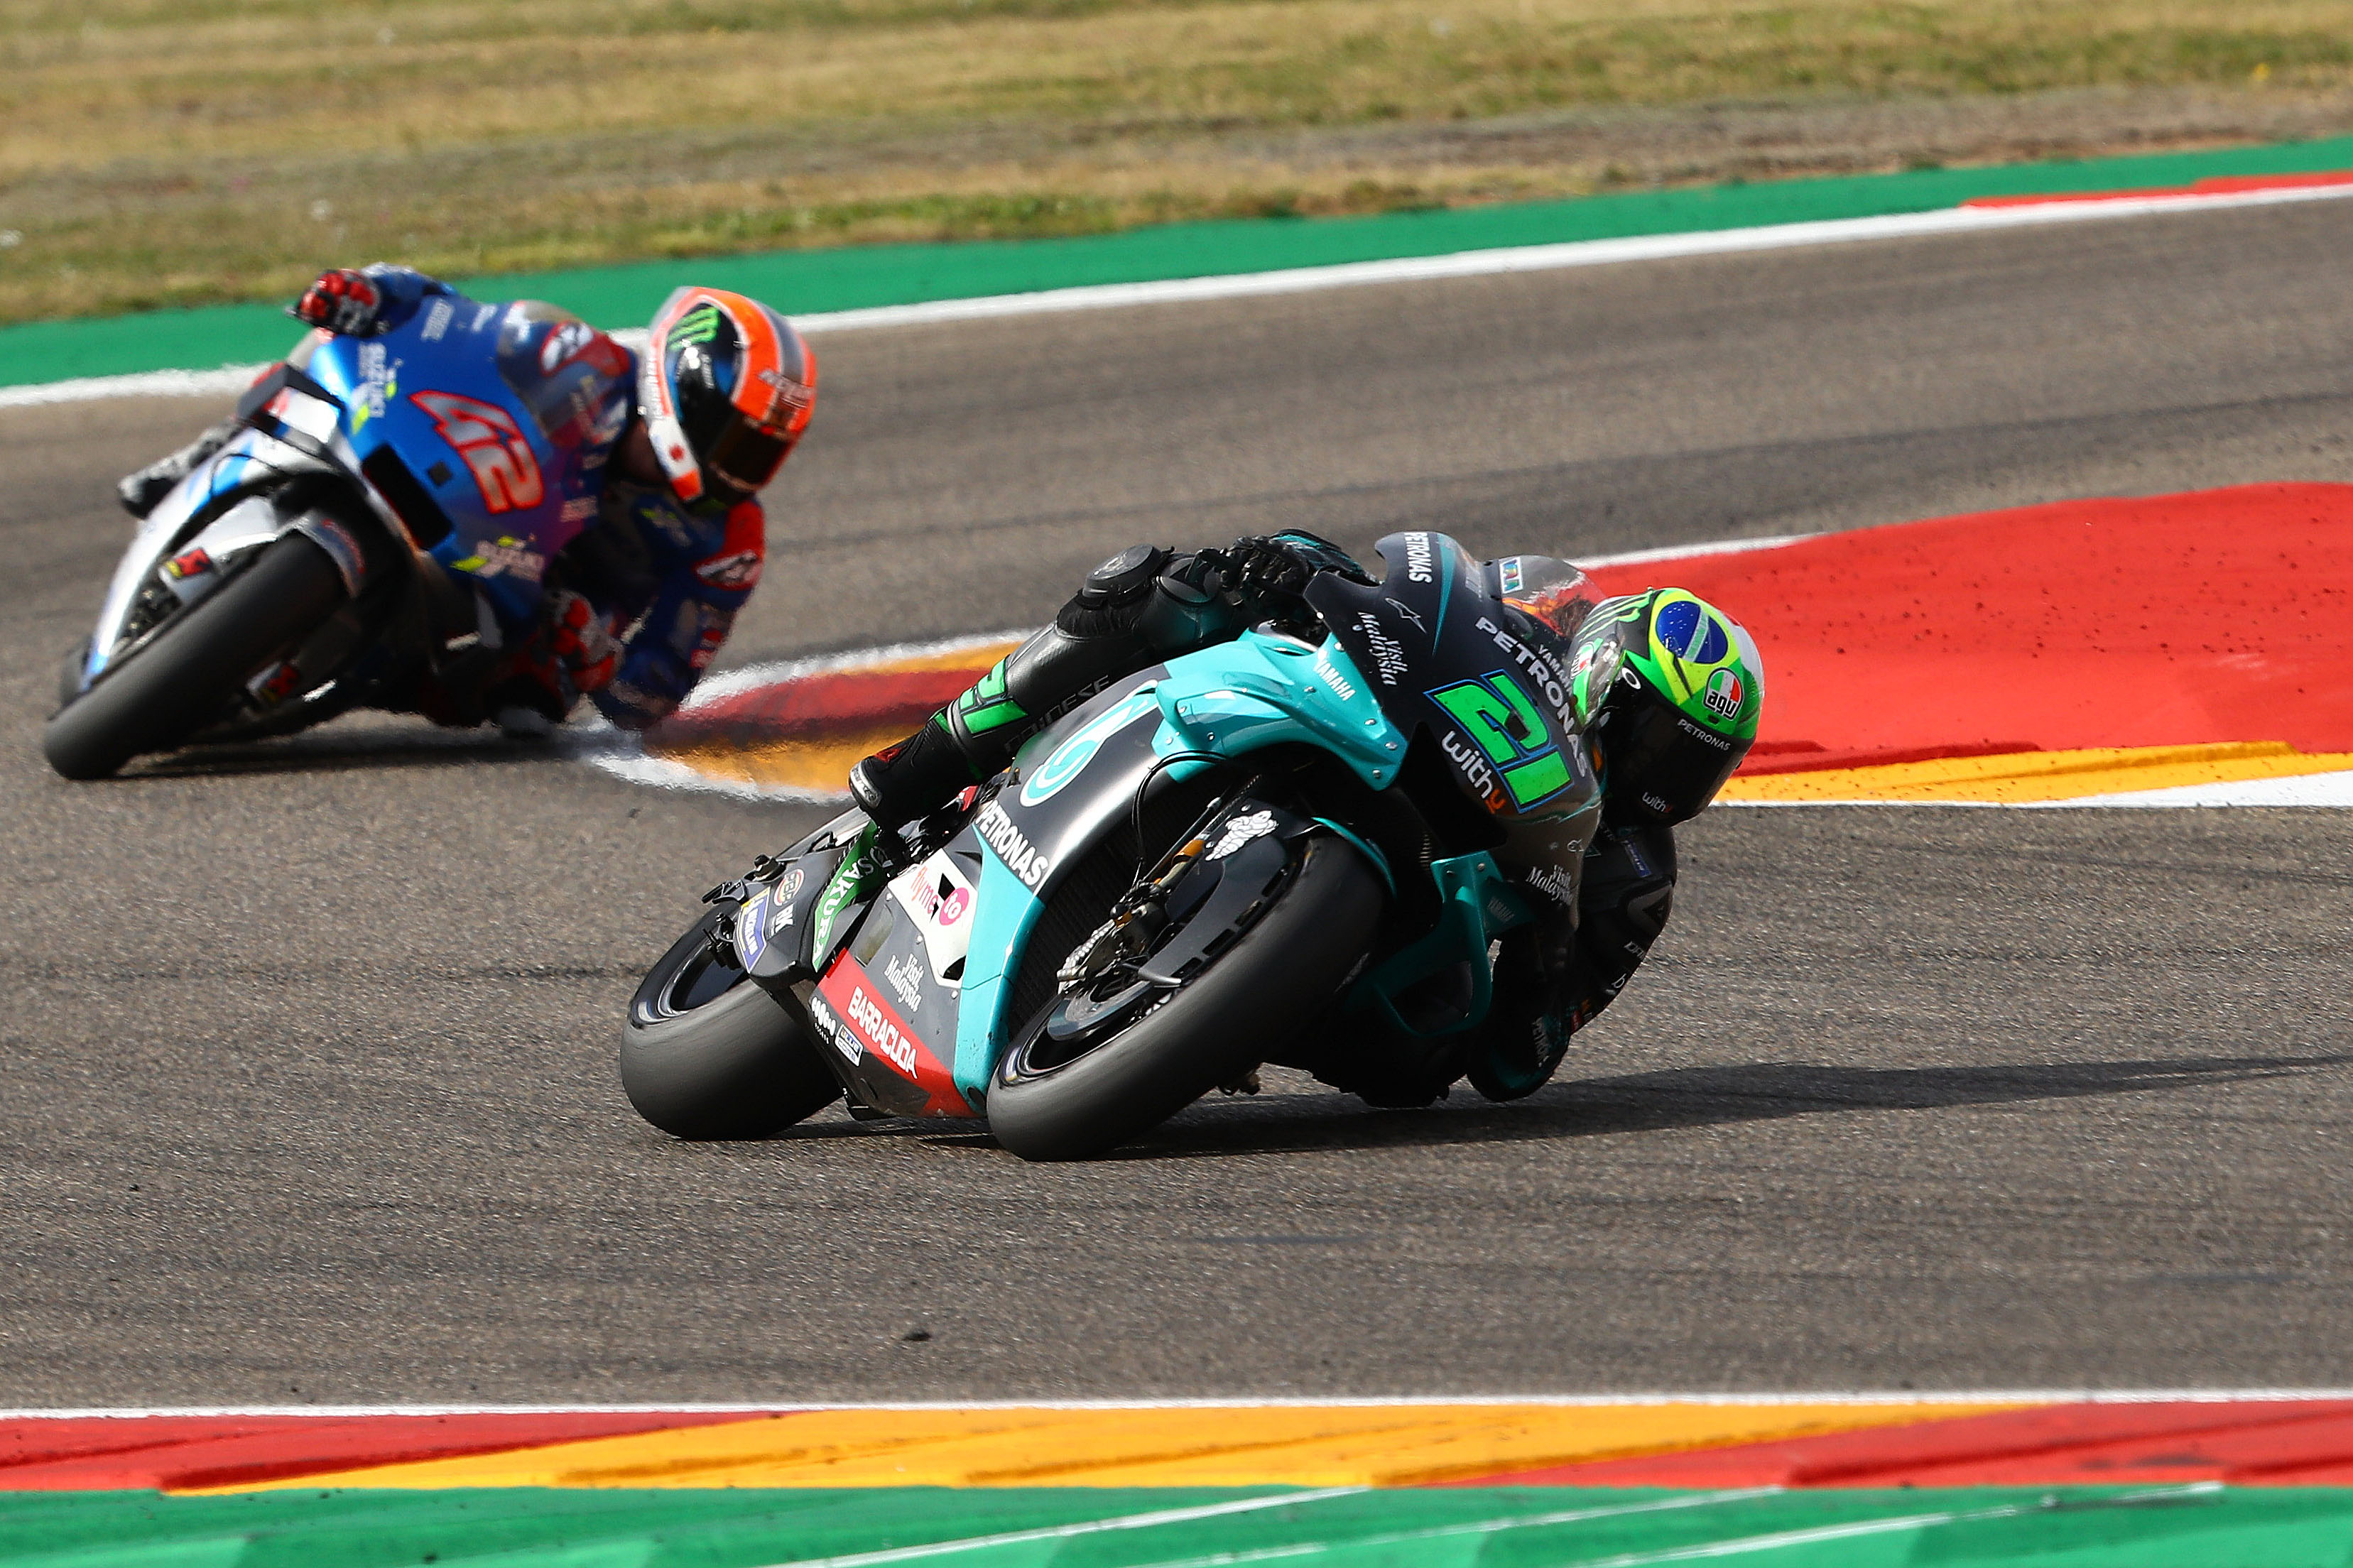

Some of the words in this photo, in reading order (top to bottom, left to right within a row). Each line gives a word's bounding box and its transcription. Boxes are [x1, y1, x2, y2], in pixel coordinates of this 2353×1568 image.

[409, 390, 544, 514] 42
[1357, 611, 1398, 686] Malaysia
[1385, 640, 1409, 672] Visit
[1314, 660, 1357, 702] YAMAHA
[1475, 616, 1588, 778] PETRONAS
[1706, 690, 1737, 716] agv
[1428, 670, 1574, 811] 21
[1677, 719, 1731, 751] PETRONAS
[975, 800, 1049, 886] PETRONAS
[745, 908, 759, 955] MICHELIN
[813, 856, 874, 964] SAKURA
[943, 892, 962, 920] to
[884, 954, 923, 1012] Malaysia
[904, 953, 924, 991] Visit
[847, 986, 918, 1079] BARRACUDA
